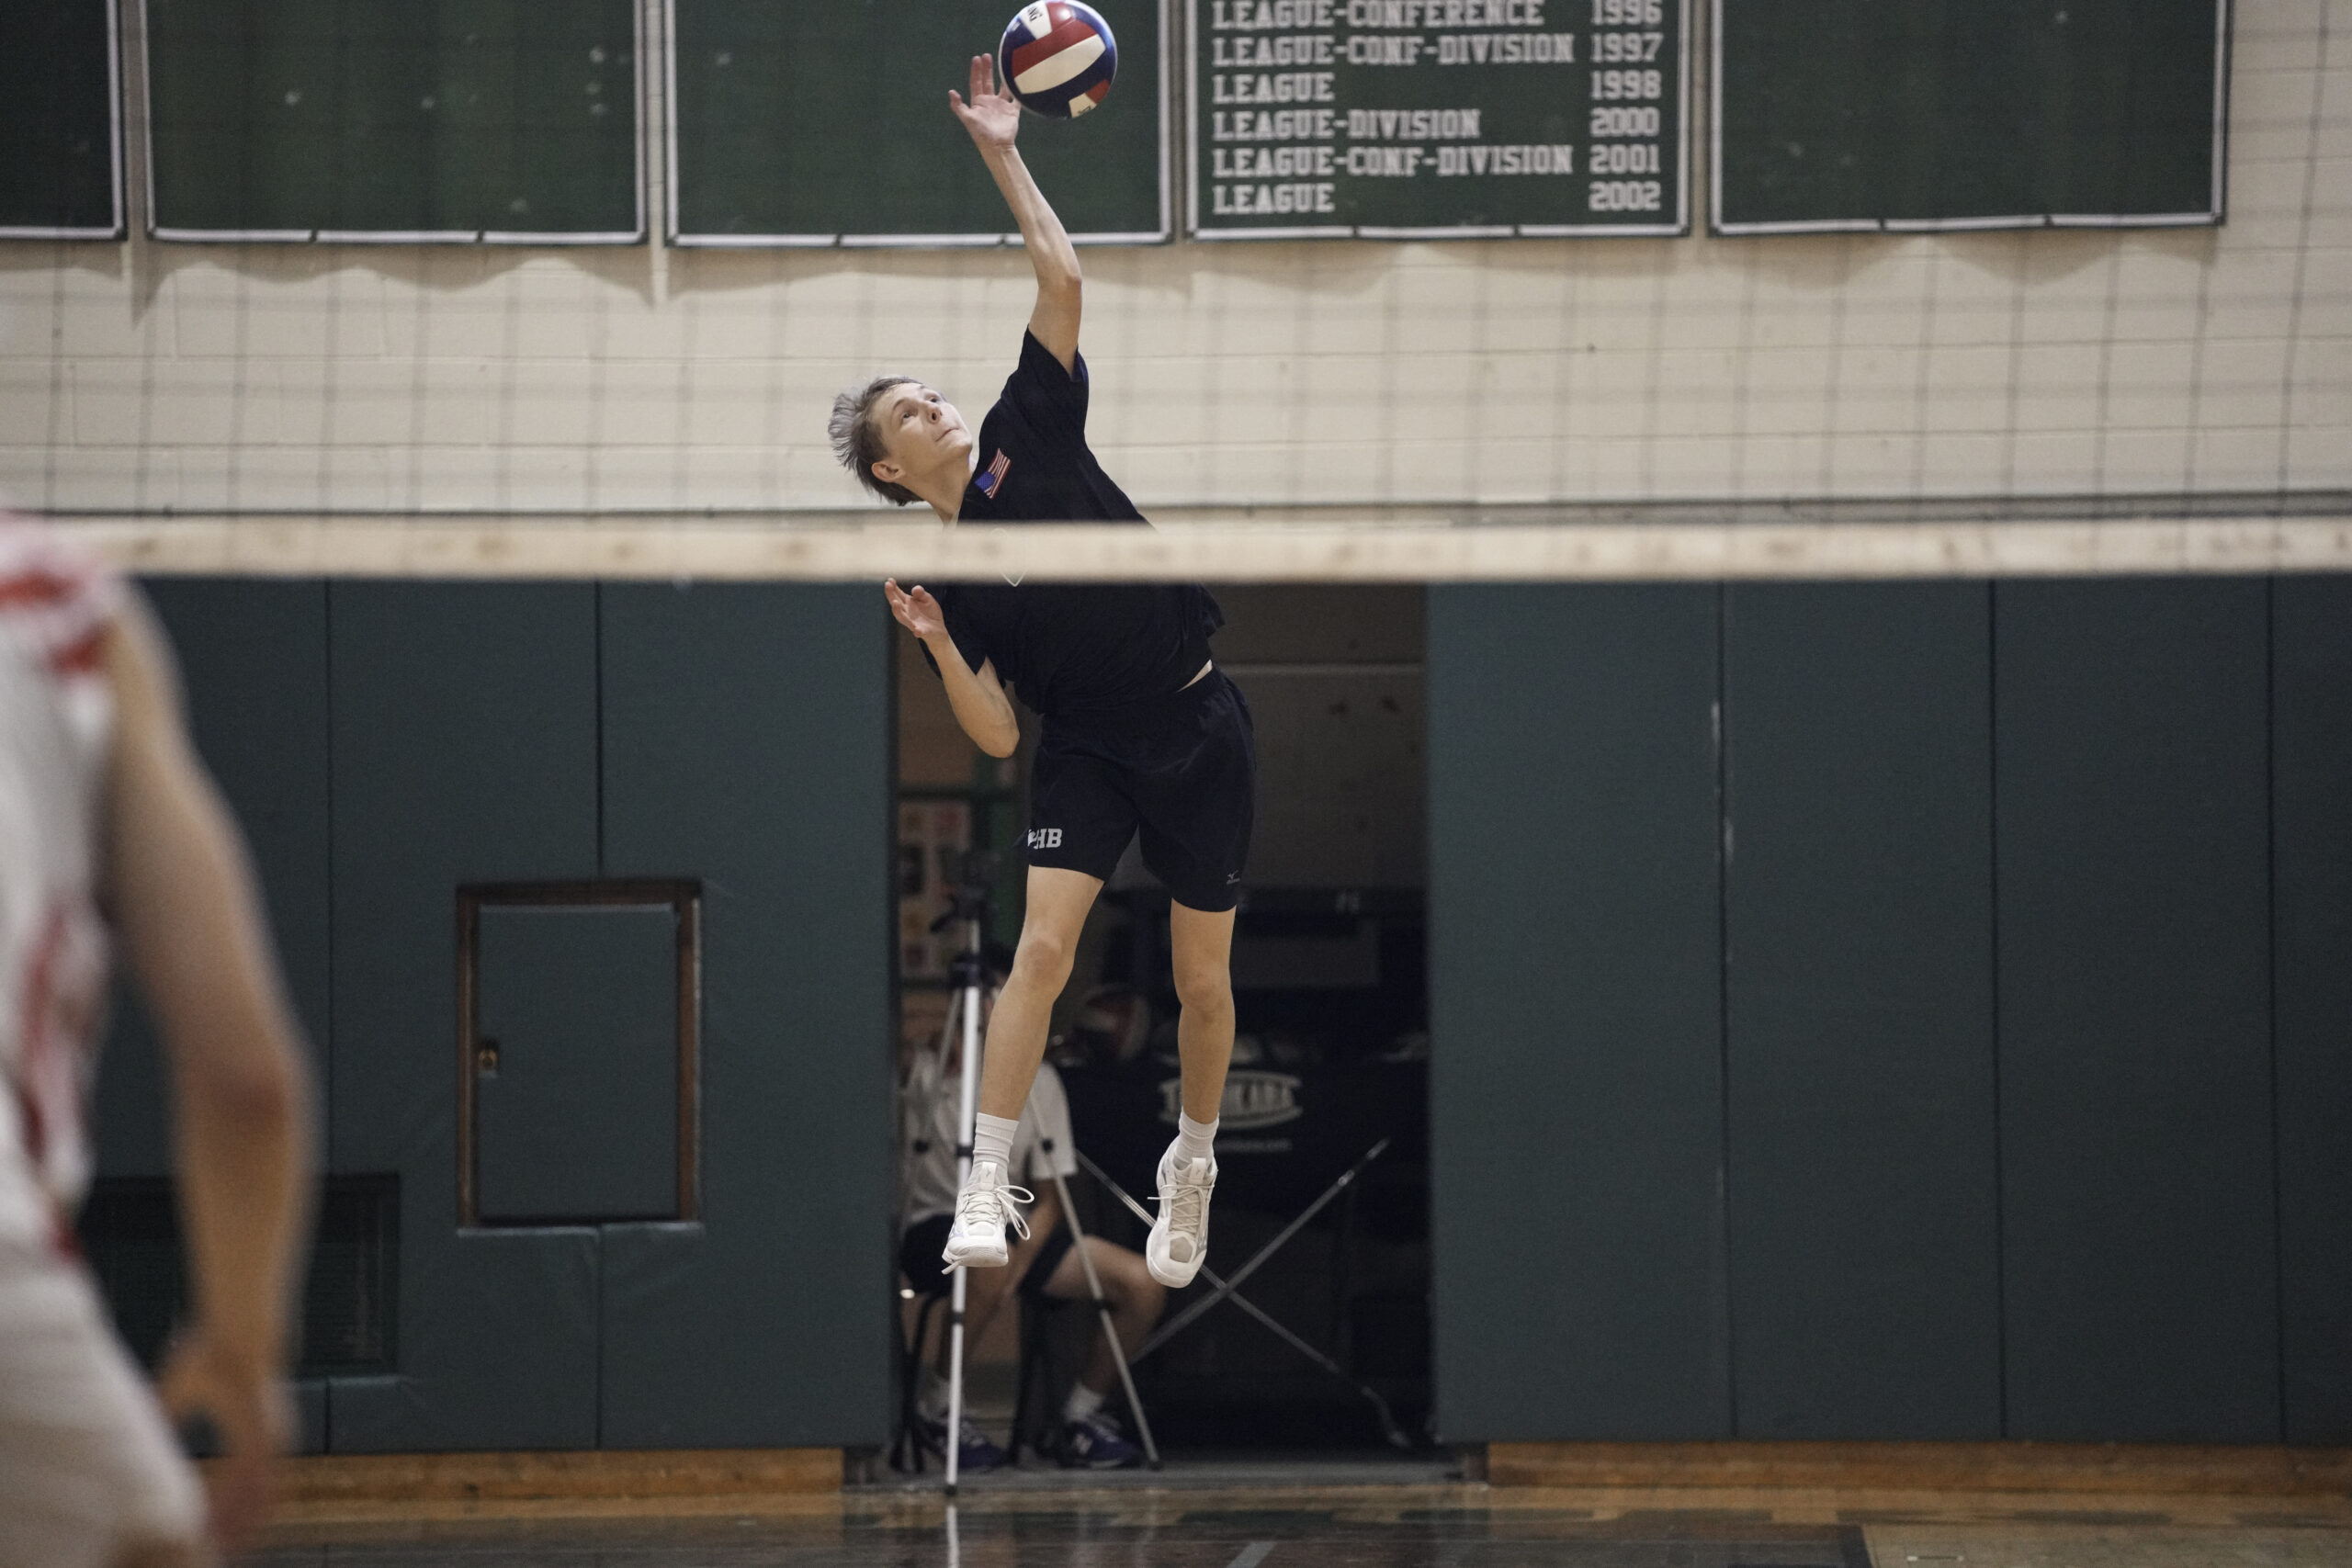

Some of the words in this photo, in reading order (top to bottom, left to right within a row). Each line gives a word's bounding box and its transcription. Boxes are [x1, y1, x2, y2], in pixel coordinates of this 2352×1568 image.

[1212, 0, 1544, 29] LEAGUE-CONFERENCE
[1590, 0, 1663, 25] 1996
[1212, 33, 1576, 67] LEAGUE-CONF-DIVISION
[1590, 32, 1665, 63] 1997
[1212, 73, 1335, 105] LEAGUE
[1590, 70, 1663, 101] 1998
[1212, 108, 1481, 141] LEAGUE-DIVISION
[1590, 107, 1660, 137] 2000
[1212, 144, 1574, 178] LEAGUE-CONF-DIVISION
[1589, 143, 1661, 175] 2001
[1212, 183, 1336, 215] LEAGUE
[1589, 180, 1662, 211] 2002
